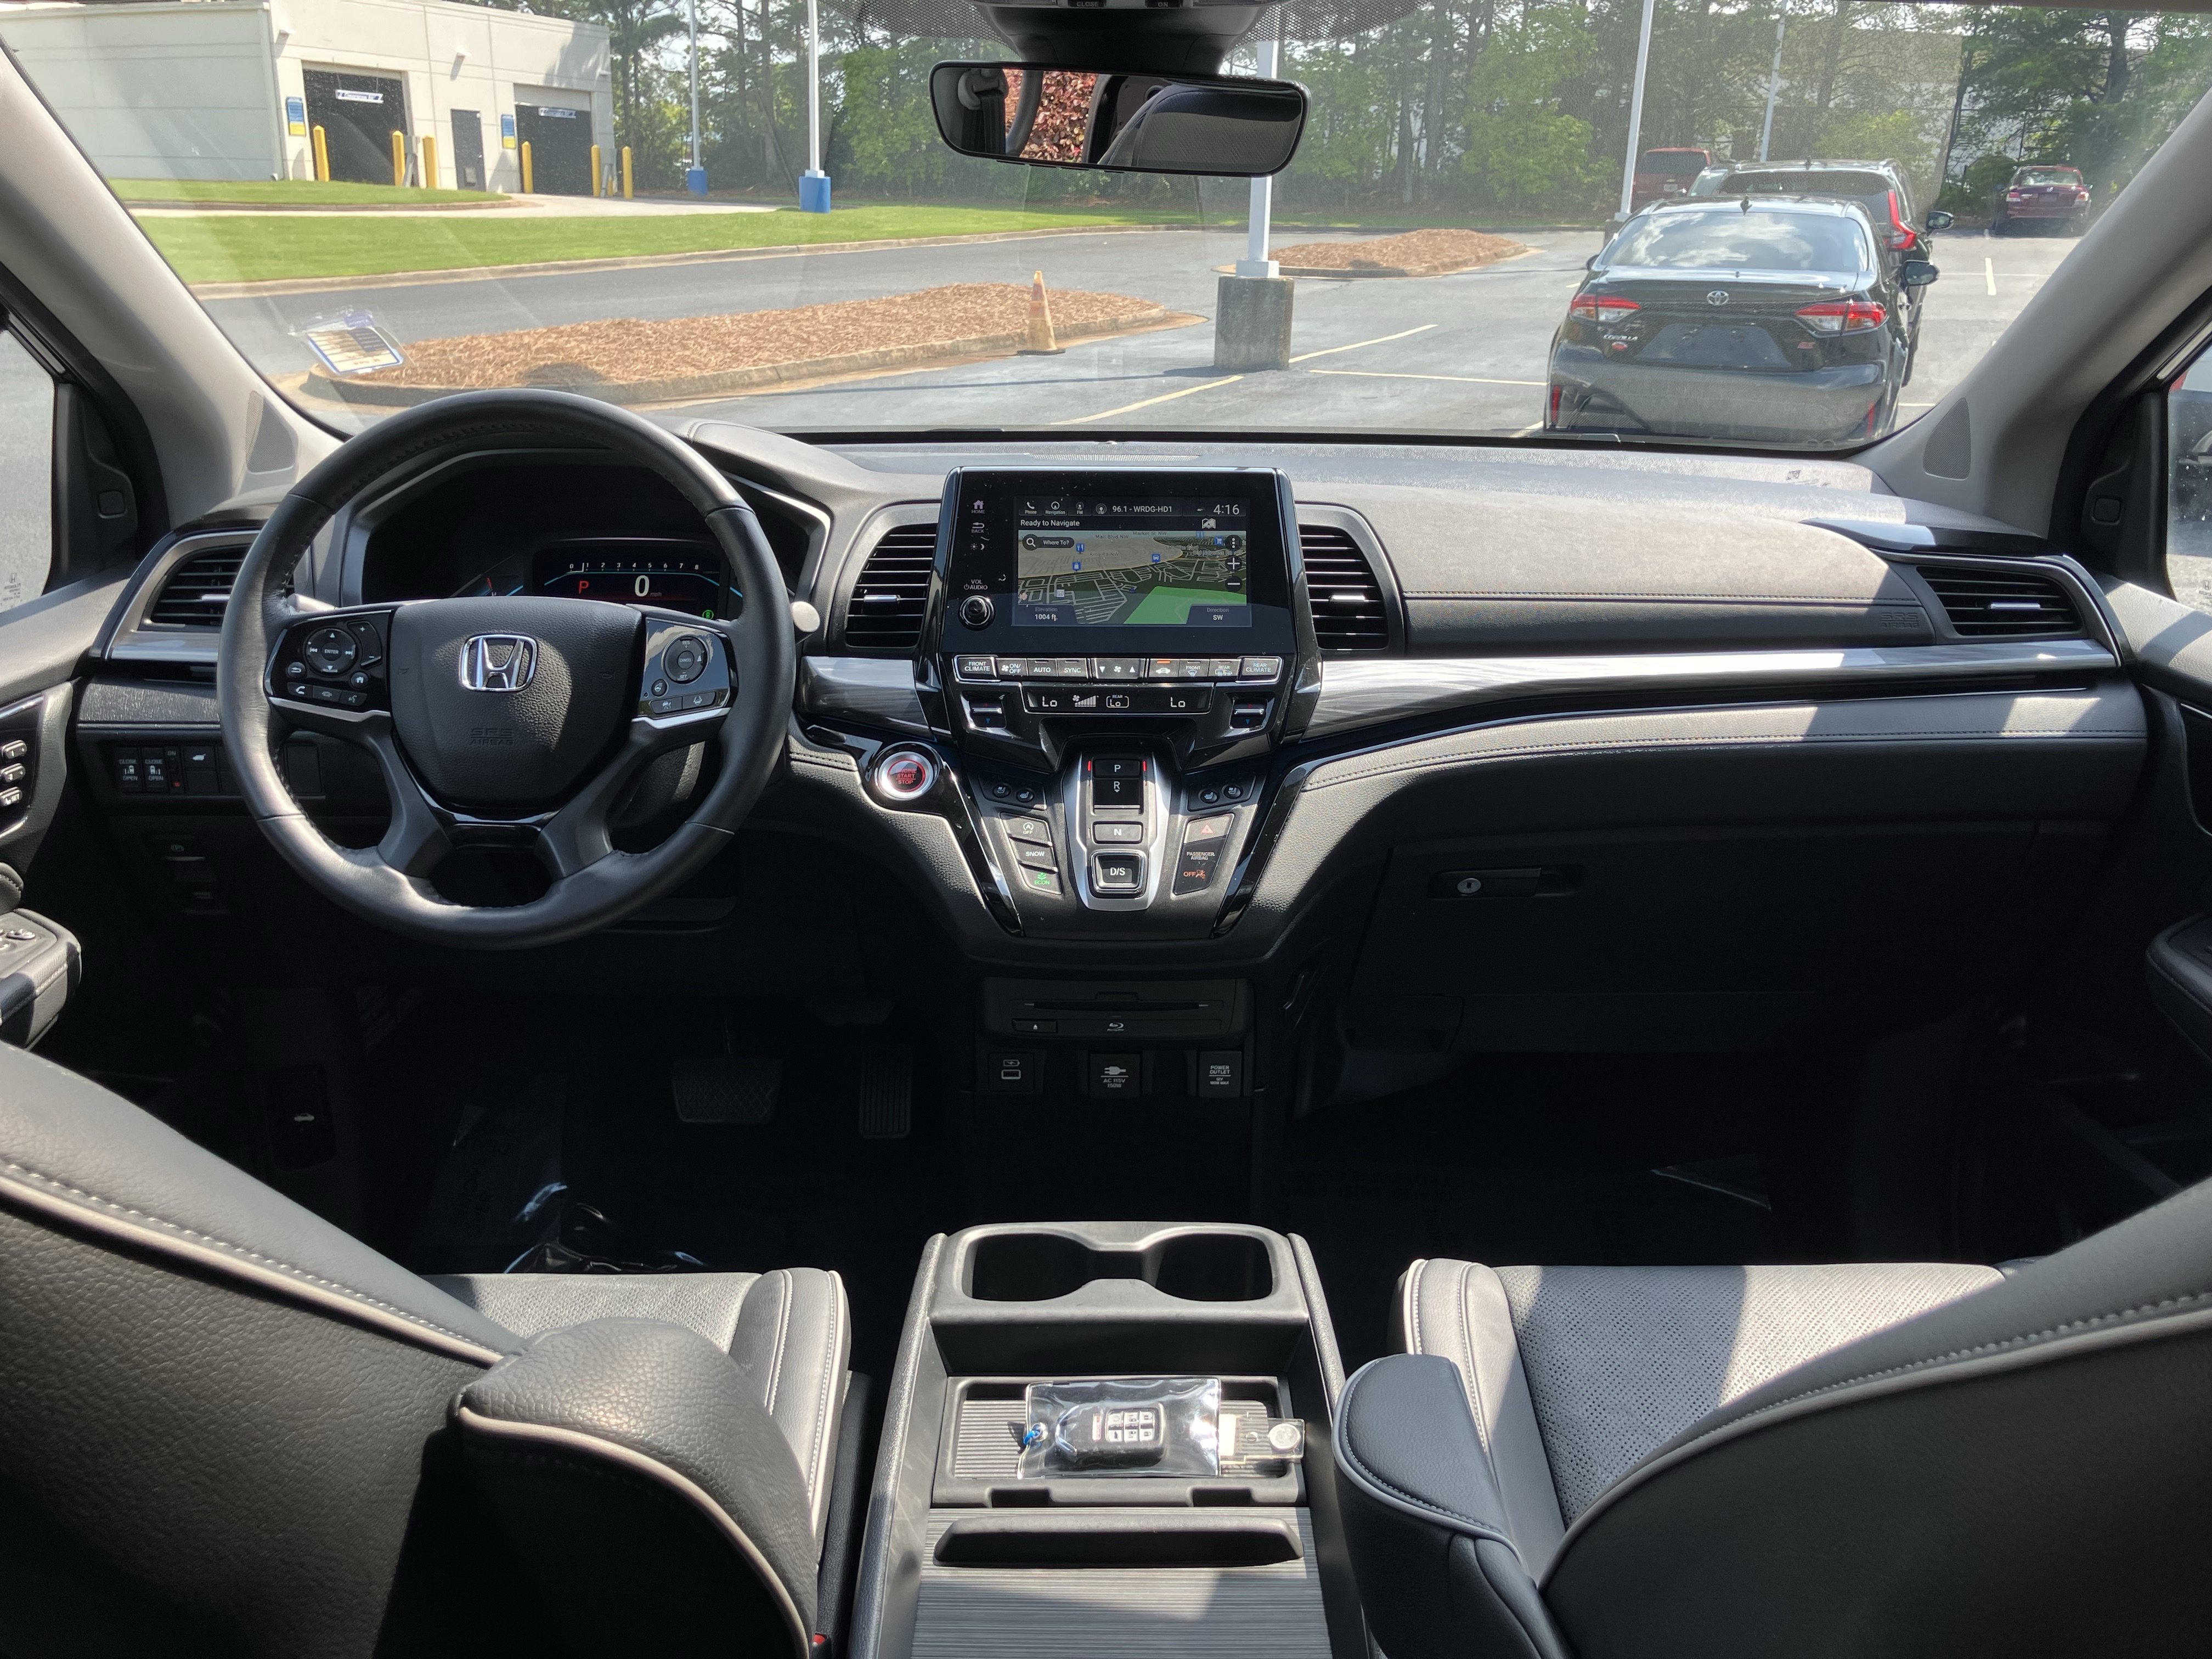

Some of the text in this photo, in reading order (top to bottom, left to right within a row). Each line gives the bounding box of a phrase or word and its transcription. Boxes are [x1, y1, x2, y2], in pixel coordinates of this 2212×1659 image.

[1213, 504, 1240, 515] 4:16
[578, 580, 589, 594] P
[634, 575, 650, 597] 0
[1881, 612, 1918, 620] SRS
[1042, 696, 1057, 707] Lo
[1110, 698, 1121, 707] Lo
[1170, 696, 1186, 708] Lo
[471, 727, 514, 736] SRS
[1114, 764, 1121, 772] P
[1113, 781, 1120, 789] R
[1110, 867, 1126, 876] D/S
